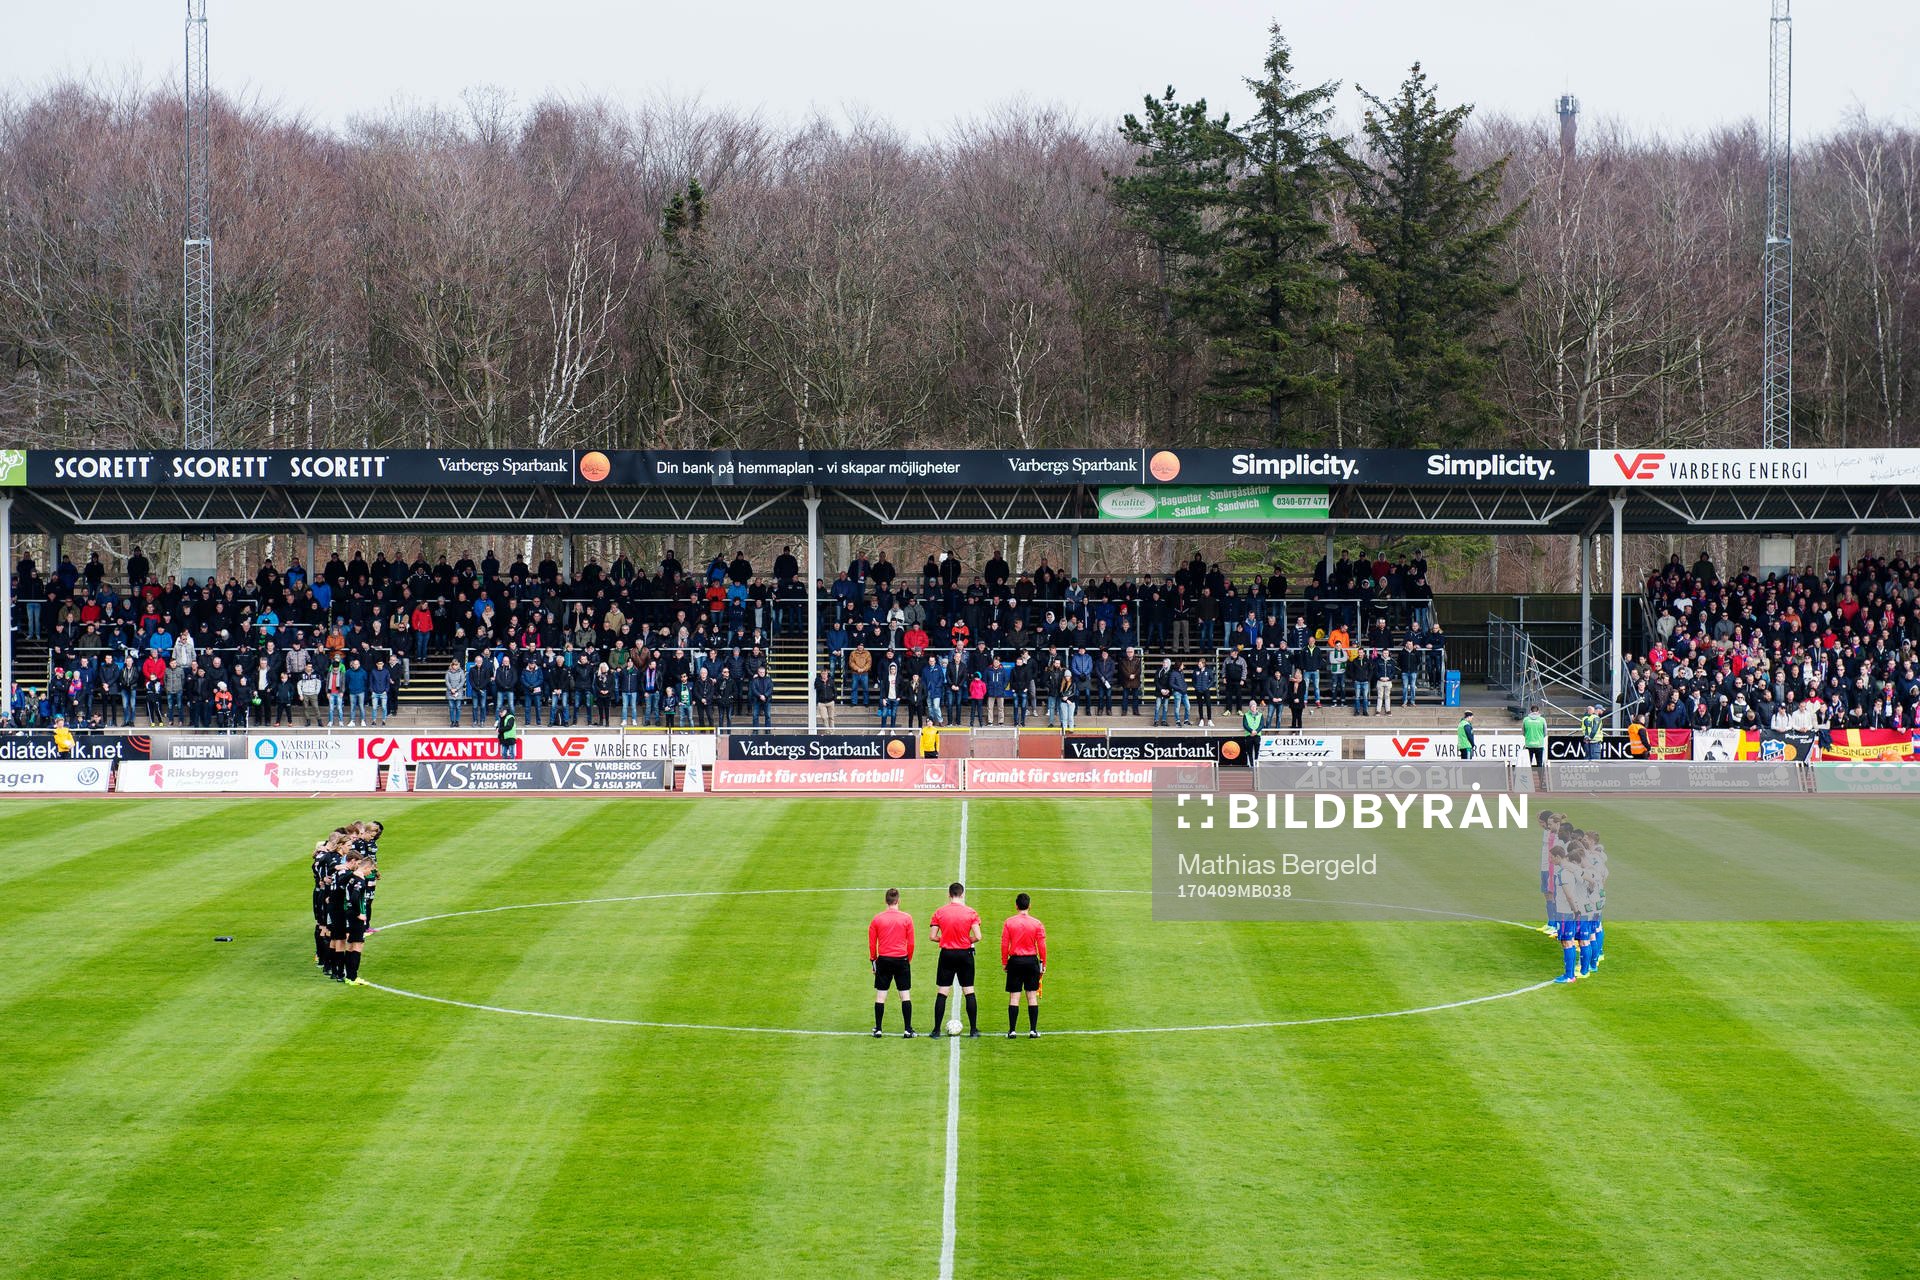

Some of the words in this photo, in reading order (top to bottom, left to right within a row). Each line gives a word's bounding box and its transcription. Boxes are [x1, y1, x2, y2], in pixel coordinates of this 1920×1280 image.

[55, 456, 150, 478] SCORETT
[173, 456, 268, 478] SCORETT
[291, 456, 386, 478] SCORETT
[438, 457, 500, 474] Varbergs
[502, 457, 569, 474] Sparbank
[656, 461, 679, 474] Din
[683, 461, 714, 474] bank
[718, 460, 734, 477] på
[738, 461, 814, 478] hemmaplan
[827, 461, 838, 474] vi
[841, 461, 886, 478] skapar
[888, 461, 961, 478] möjligheter
[1008, 457, 1069, 474] Varbergs
[1072, 457, 1138, 474] Sparbank
[1232, 454, 1359, 479] Simplicity.
[1427, 454, 1556, 480] Simplicity.
[1669, 462, 1742, 480] VARBERG
[1750, 461, 1808, 480] ENERGI
[0, 741, 123, 759] diatekik.net
[281, 740, 341, 750] VARBERGS
[594, 743, 648, 757] VARBERG
[653, 743, 690, 757] ENER
[1275, 738, 1315, 746] CREMO
[281, 751, 328, 760] BOSTAD
[739, 741, 805, 760] Varbergs
[809, 741, 881, 760] Sparbank
[1072, 743, 1139, 760] Varbergs
[1144, 743, 1216, 760] Sparbank
[1435, 744, 1486, 757] VARRG
[167, 768, 239, 779] Riksbyggen
[282, 767, 354, 778] Riksbyggen
[470, 763, 518, 771] VARBERGS
[594, 762, 642, 770] VARBERGS
[1560, 765, 1600, 773] CUSTOM
[426, 763, 468, 789] VS
[470, 772, 533, 780] STADSHOTELL
[549, 763, 593, 789] VS
[594, 772, 657, 780] STADSHOTELL
[719, 769, 772, 784] Framåt
[774, 769, 796, 784] för
[799, 769, 847, 783] svensk
[973, 769, 1025, 783] Framåt
[1027, 768, 1050, 783] för
[1052, 768, 1101, 783] svensk
[1425, 766, 1473, 789] BIL
[1561, 780, 1621, 788] PAPERBOARD
